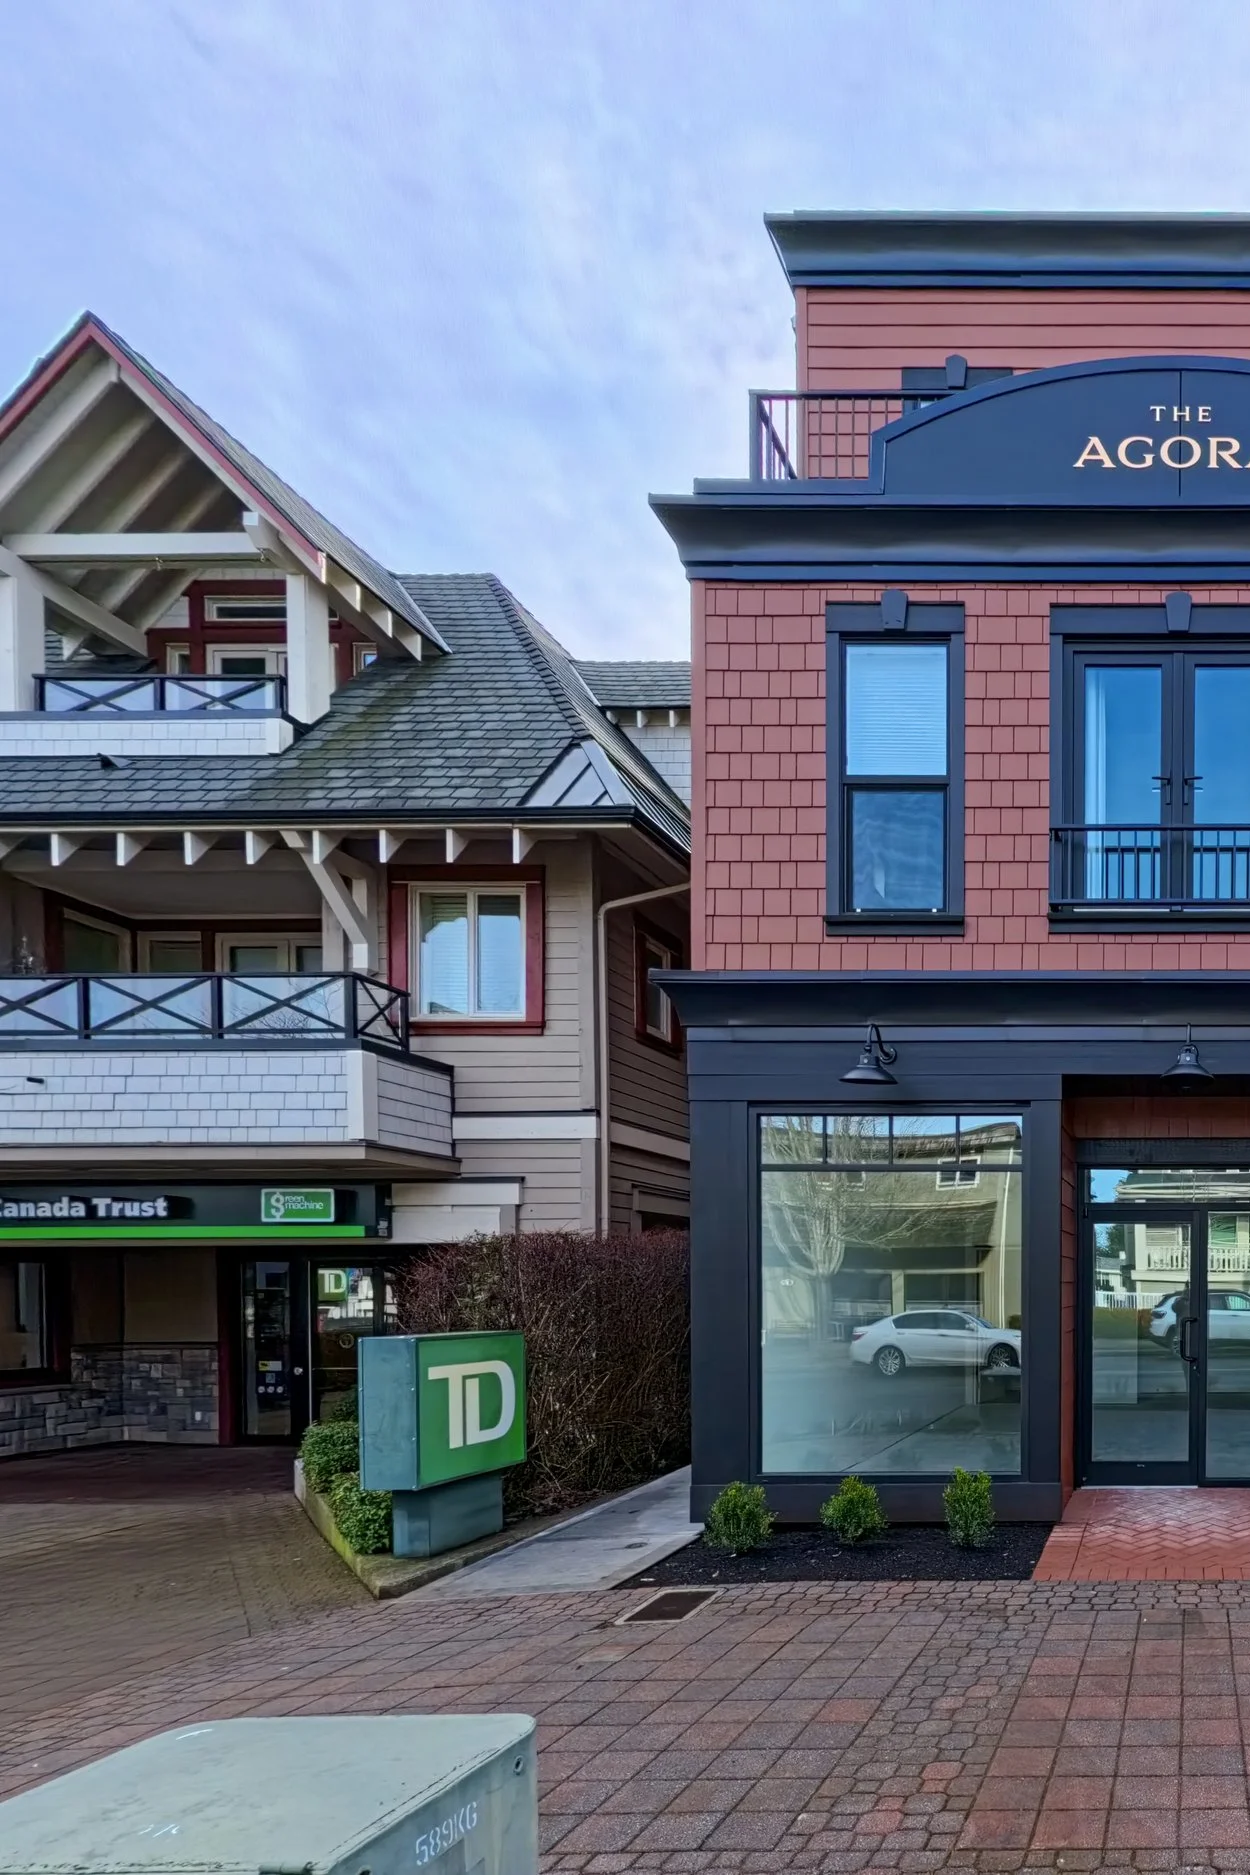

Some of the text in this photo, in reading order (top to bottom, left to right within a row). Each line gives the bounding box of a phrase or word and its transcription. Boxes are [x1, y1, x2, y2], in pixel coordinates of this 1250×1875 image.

[1150, 406, 1212, 422] THE
[0, 1196, 168, 1218] anada Trust
[284, 1200, 324, 1210] machine
[318, 1269, 347, 1293] TD
[428, 1360, 516, 1449] TD
[415, 1801, 478, 1866] 589KG
